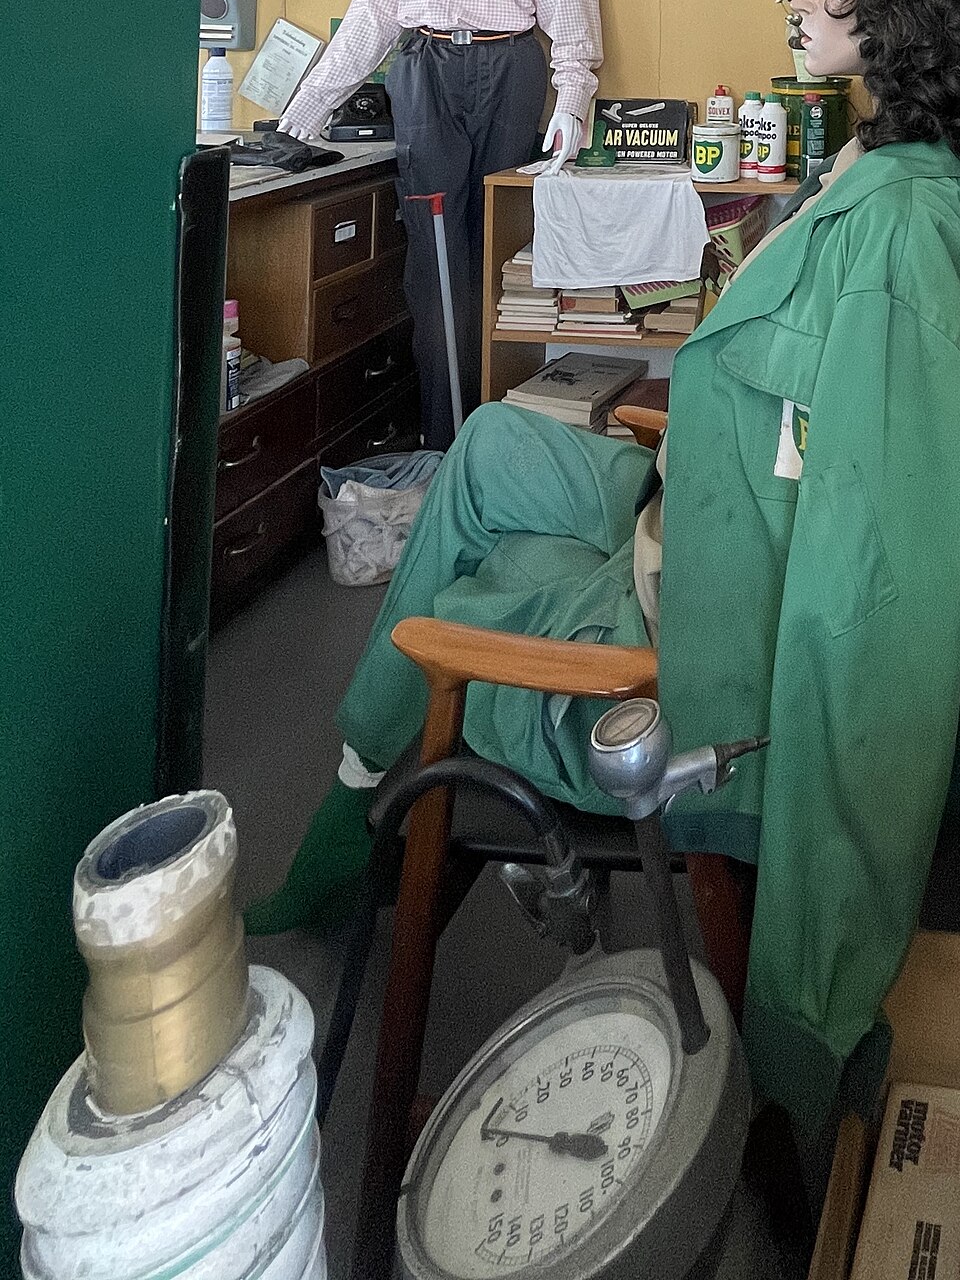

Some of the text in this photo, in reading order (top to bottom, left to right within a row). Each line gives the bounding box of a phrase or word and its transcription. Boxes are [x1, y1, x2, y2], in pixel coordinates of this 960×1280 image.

[707, 106, 731, 116] SOLVEX
[604, 129, 679, 146] AR VACUUM
[695, 145, 721, 166] BP
